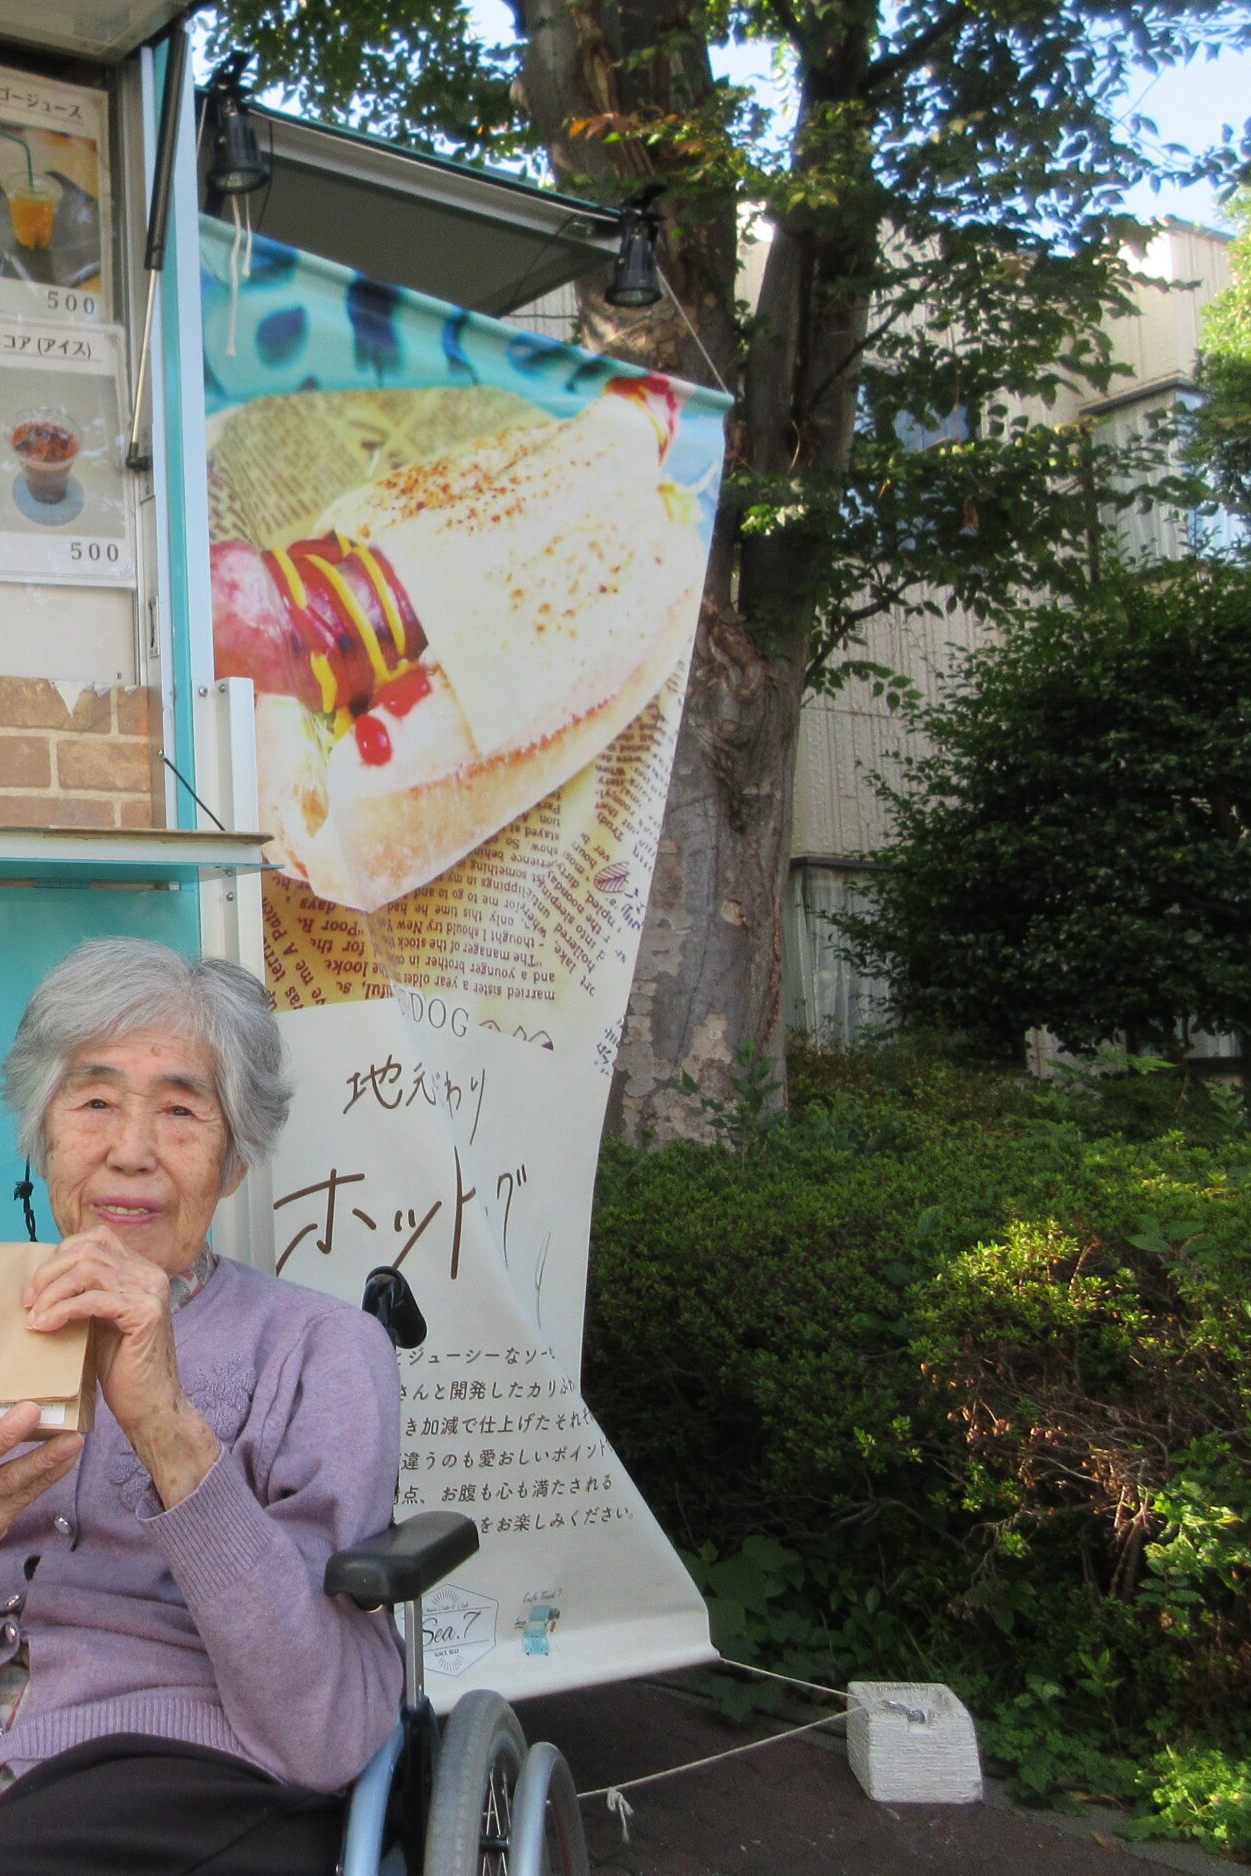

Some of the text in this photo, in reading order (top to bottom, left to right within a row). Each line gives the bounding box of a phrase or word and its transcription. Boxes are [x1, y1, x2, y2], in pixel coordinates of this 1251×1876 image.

[47, 291, 95, 315] 500
[71, 542, 120, 562] 500
[469, 860, 527, 880] something
[452, 888, 463, 900] go
[467, 892, 477, 904] to
[482, 895, 498, 907] me
[435, 905, 457, 917] time
[463, 908, 482, 922] this
[490, 911, 514, 926] only
[397, 920, 423, 934] New
[427, 919, 442, 933] try
[446, 922, 479, 938] should
[398, 937, 426, 949] stock
[429, 939, 447, 952] the
[491, 931, 535, 948] thought
[343, 941, 365, 956] for
[450, 941, 460, 954] of
[463, 943, 509, 961] manager
[554, 923, 595, 973] hollered
[425, 956, 465, 974] brother
[470, 962, 514, 979] younger
[435, 975, 457, 988] year
[521, 971, 527, 981] a
[533, 972, 555, 984] and
[463, 980, 469, 991] a
[473, 983, 501, 997] sister
[507, 987, 555, 1001] married
